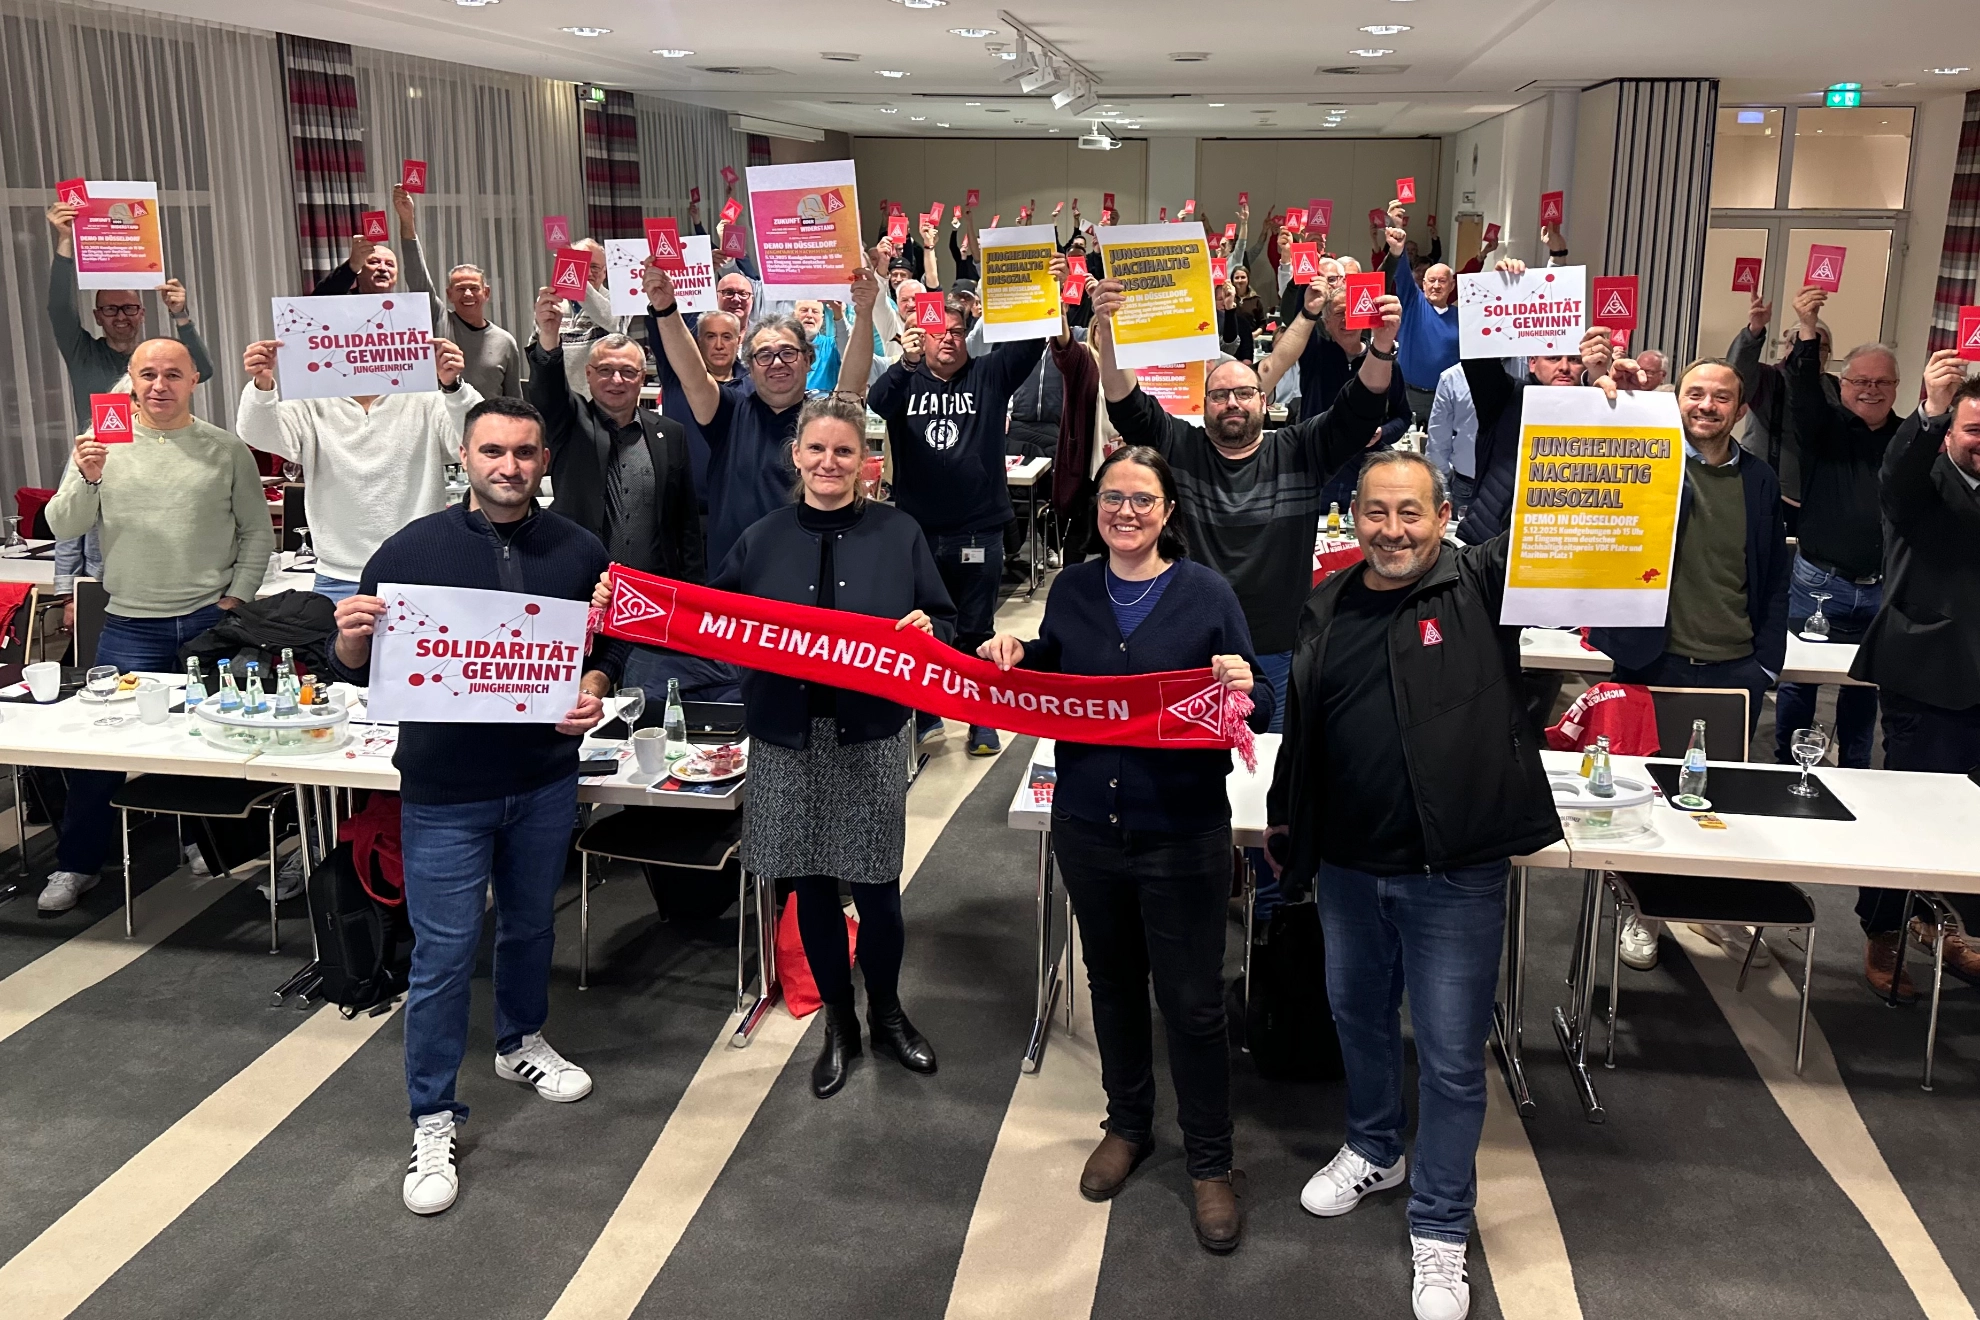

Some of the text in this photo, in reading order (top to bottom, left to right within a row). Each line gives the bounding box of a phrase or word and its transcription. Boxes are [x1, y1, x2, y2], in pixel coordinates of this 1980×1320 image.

[773, 217, 800, 225] ZUKUNFT
[800, 224, 835, 232] WIDERSTAND
[793, 240, 837, 249] DÜSSELDORF
[986, 248, 1052, 264] JUNGHEINRICH
[1109, 244, 1199, 264] JUNGHEINRICH
[987, 261, 1044, 274] NACHHALTIG
[1111, 257, 1190, 277] NACHHALTIG
[672, 276, 712, 290] WINNT
[987, 273, 1032, 285] UNSOZIAL
[1120, 274, 1176, 292] NSOZIAL
[674, 289, 702, 297] HEINRICH
[1144, 289, 1188, 301] DÜSSELDORF
[1484, 298, 1581, 317] SOLIDARITÄT
[1512, 315, 1581, 329] GEWINNT
[308, 327, 429, 350] SOLIDARITÄT
[1518, 329, 1566, 338] JUNGHEINRICH
[345, 346, 430, 364] GEWINNT
[353, 363, 413, 375] JUNGHEINRICH
[906, 391, 977, 416] LEAGUE
[1529, 437, 1670, 460] JUNGHEINRICH
[1529, 462, 1651, 484] NACHHALTIG
[1526, 487, 1624, 508] UNSOZIAL
[1524, 512, 1639, 526] DEMO IN DÜSSELDORF
[1523, 526, 1558, 534] 5.12.2025
[1559, 527, 1611, 536] Kundgebungen
[1632, 528, 1644, 536] Uhr
[1534, 535, 1562, 543] Eingang
[1521, 543, 1594, 552] Nachhaltigkeitspreis
[1610, 544, 1628, 552] Platz
[1629, 544, 1643, 552] und
[1549, 551, 1568, 559] Platz
[415, 638, 579, 662] SOLIDARITÄT
[462, 661, 577, 682] GEWINNT
[698, 611, 1130, 721] MITEINANDER FÜR MORGEN
[468, 682, 550, 694] JUNGHEINRICH
